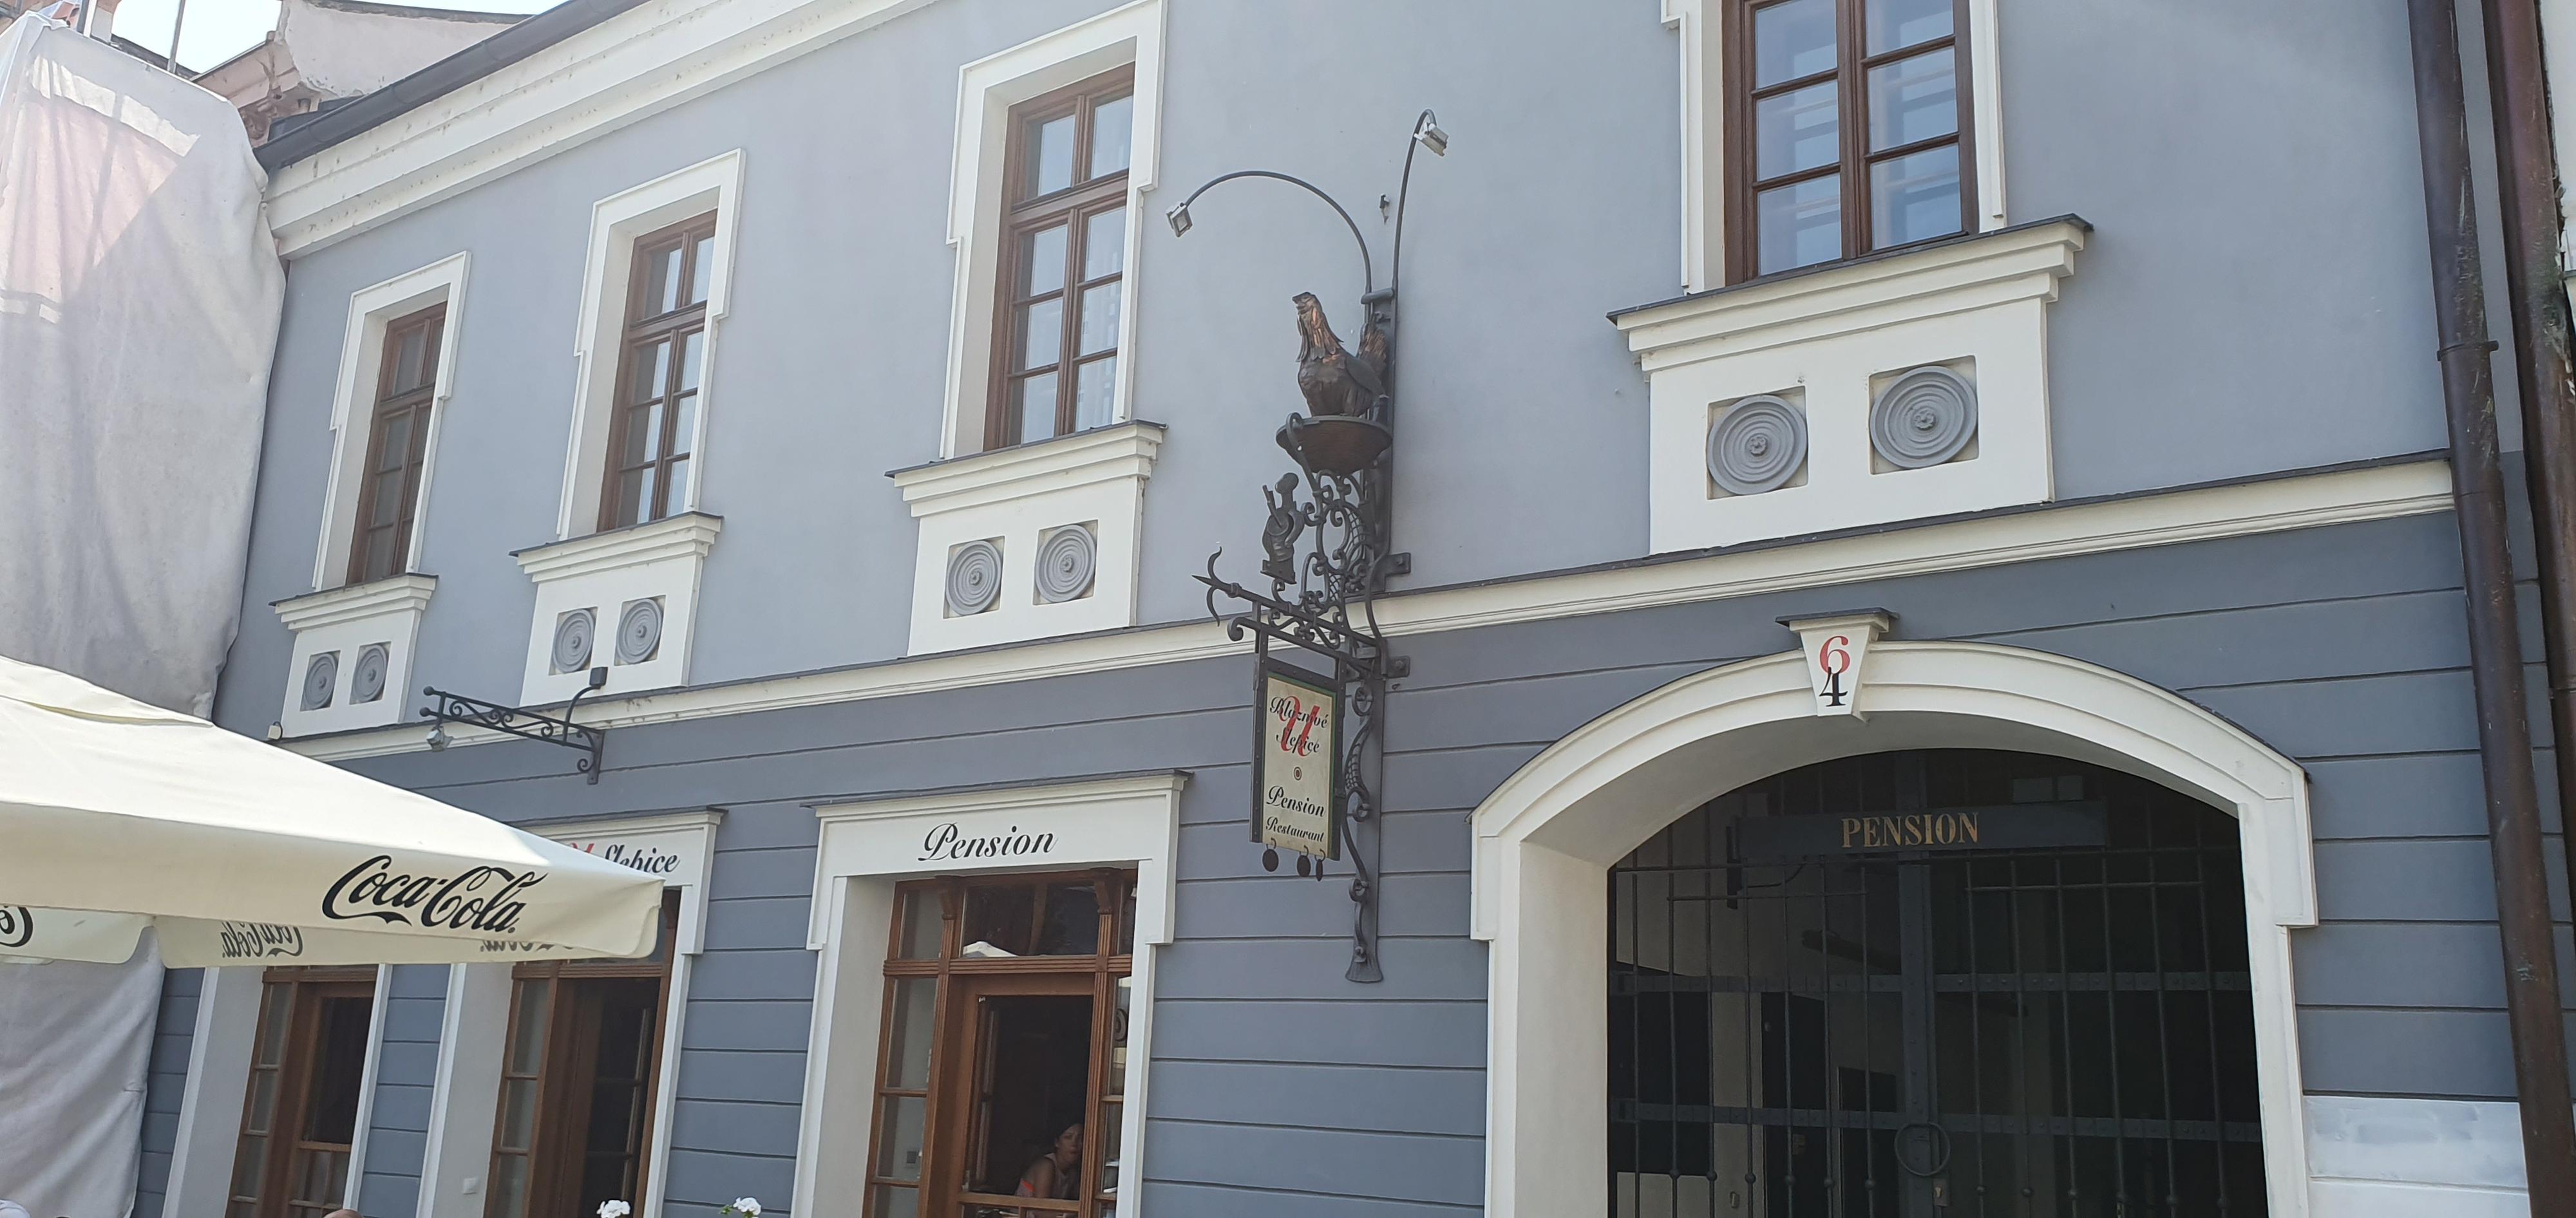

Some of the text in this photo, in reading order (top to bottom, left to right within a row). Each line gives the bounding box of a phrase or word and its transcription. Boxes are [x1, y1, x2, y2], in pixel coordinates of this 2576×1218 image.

[1266, 785, 1324, 818] Pension
[918, 822, 1059, 861] Pension
[1265, 816, 1324, 842] Restaurant
[1842, 812, 1978, 848] PENSION
[322, 855, 548, 931] Coca-Cola
